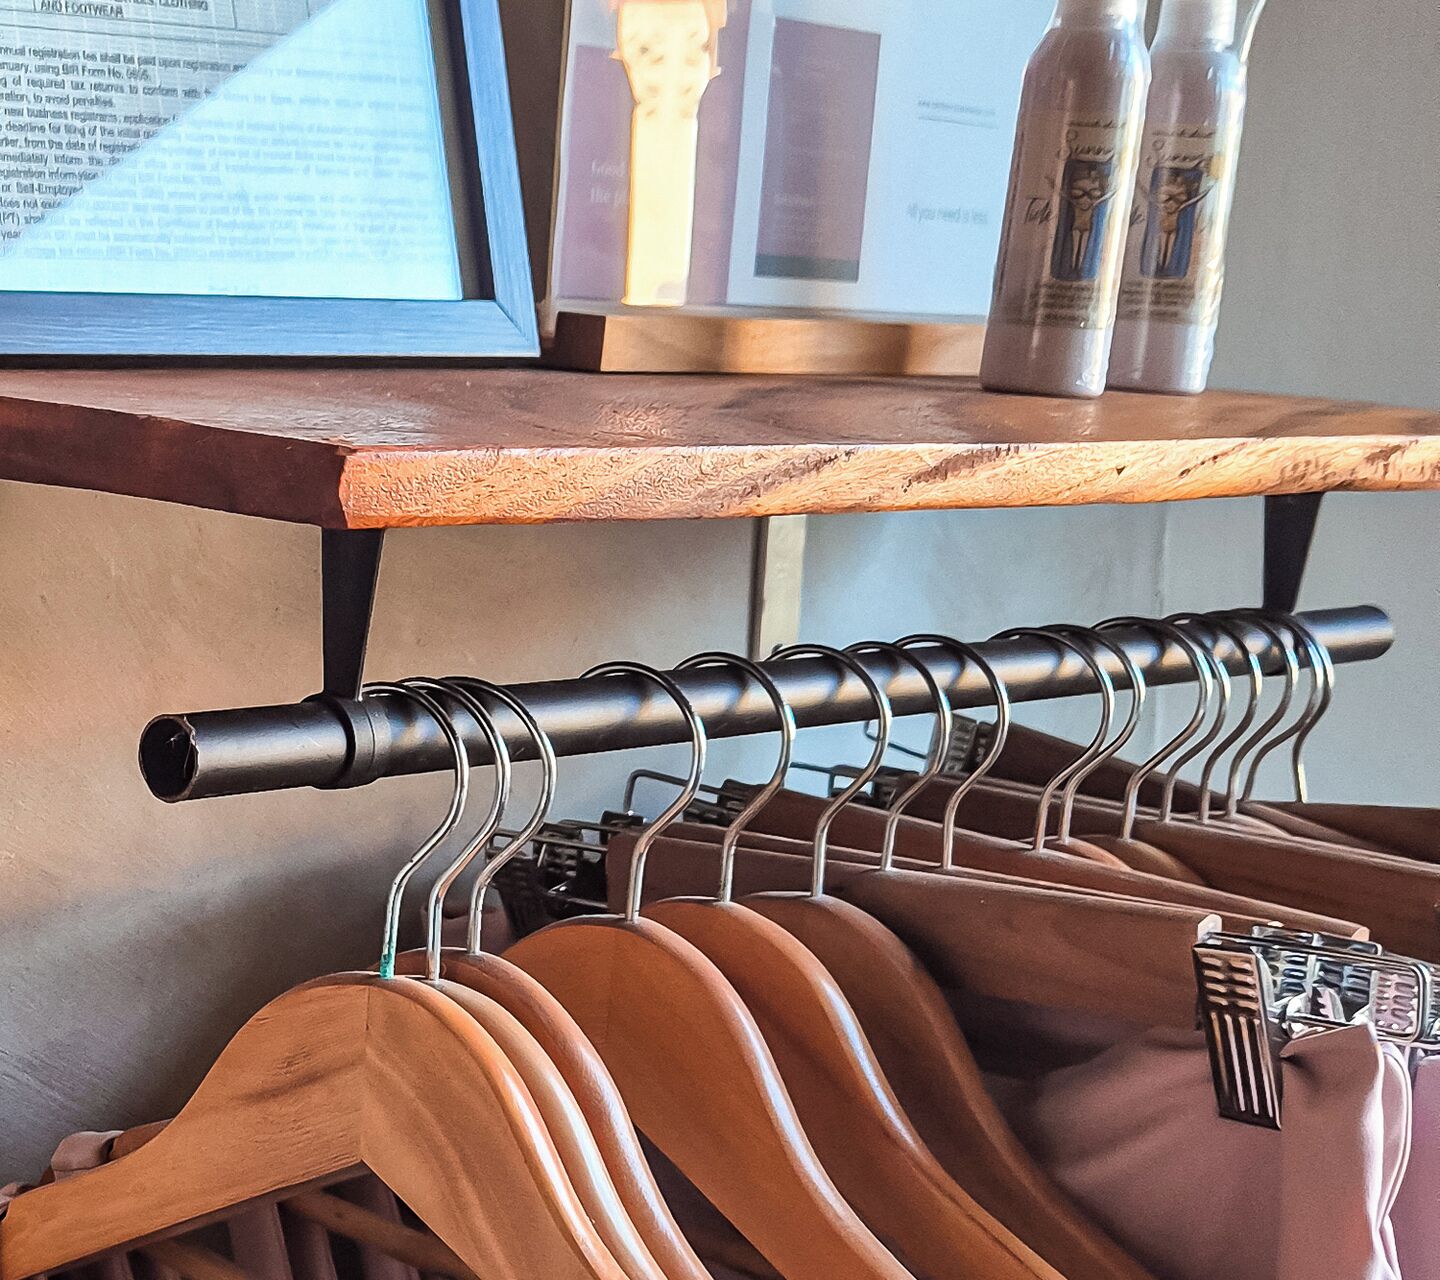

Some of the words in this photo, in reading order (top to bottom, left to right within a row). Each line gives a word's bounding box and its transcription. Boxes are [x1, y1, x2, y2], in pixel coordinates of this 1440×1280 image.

[40, 1, 63, 13] AND
[65, 2, 124, 19] FOOTWEAR
[81, 65, 106, 78] Form
[26, 77, 66, 92] required
[4, 106, 24, 118] new
[26, 107, 69, 121] business
[5, 121, 46, 133] deadline
[99, 125, 115, 137] the
[24, 136, 47, 150] from
[65, 139, 86, 151] date
[53, 153, 84, 166] inform
